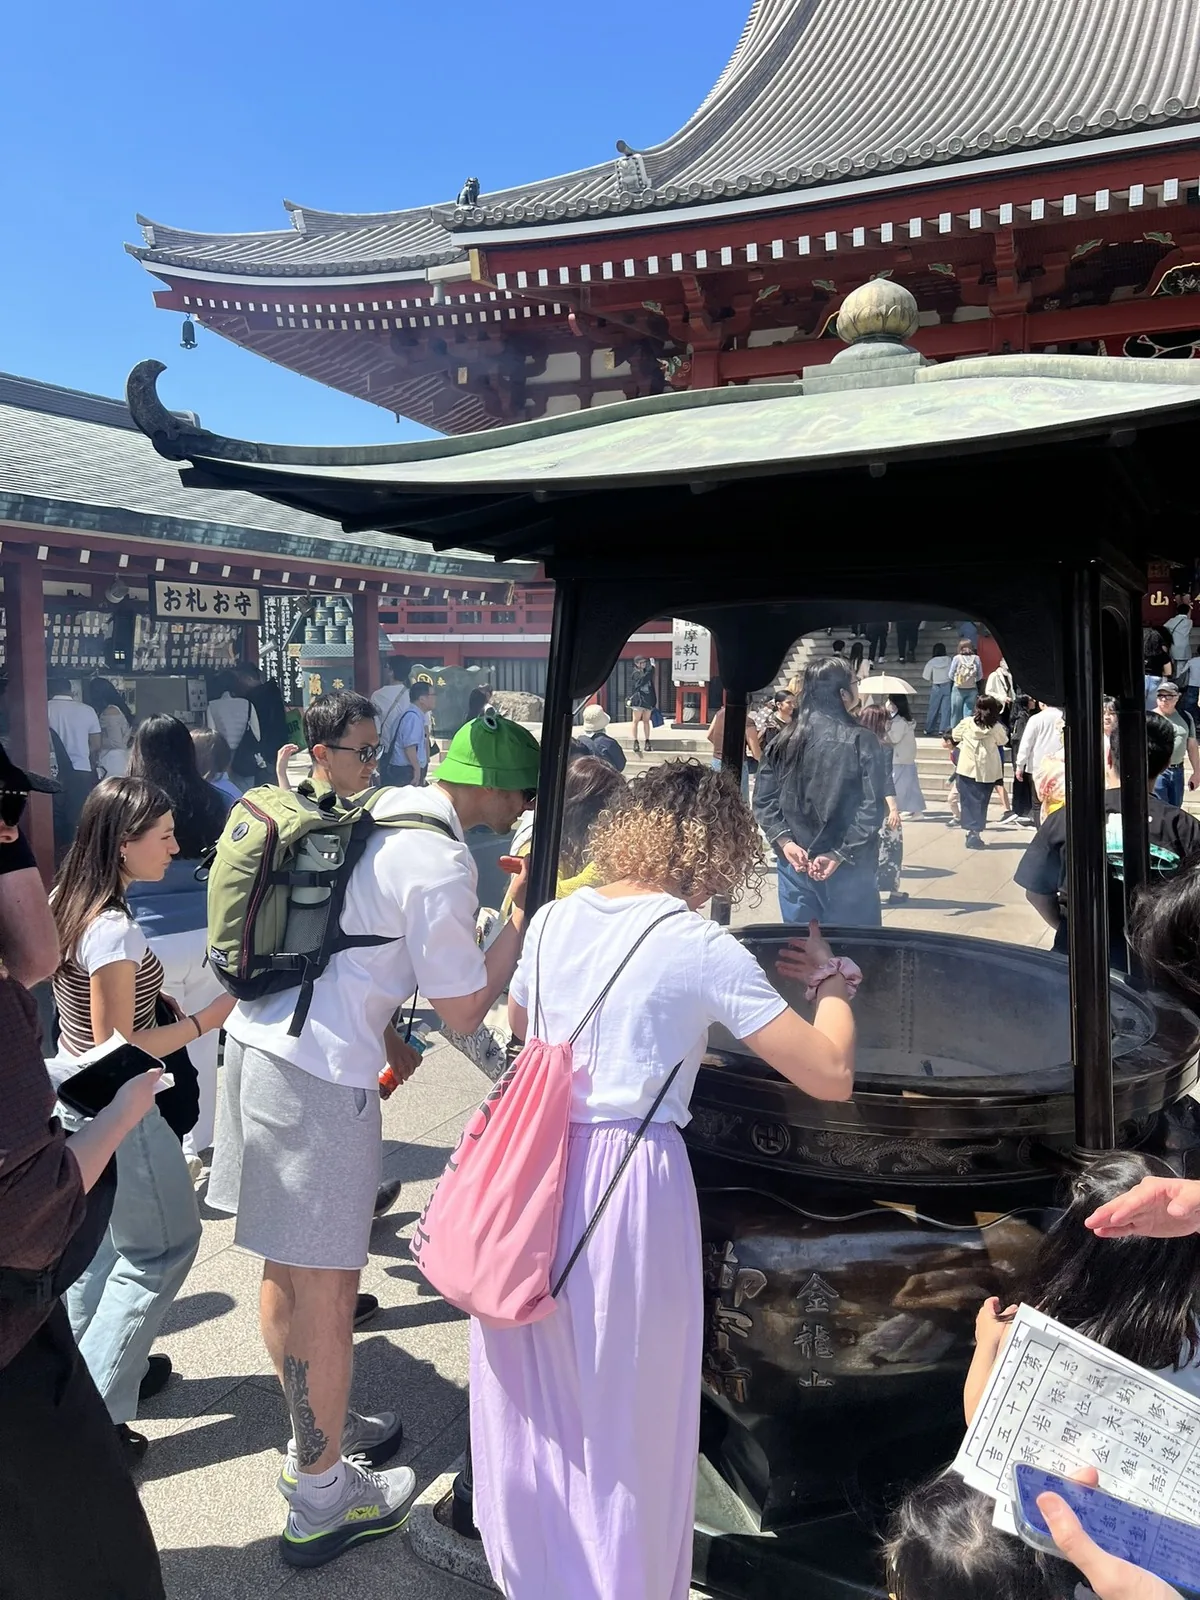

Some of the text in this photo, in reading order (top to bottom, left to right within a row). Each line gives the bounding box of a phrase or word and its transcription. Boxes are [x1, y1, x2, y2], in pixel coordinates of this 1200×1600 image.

[163, 585, 252, 617] お札お守
[793, 1272, 840, 1388] 金龍山
[345, 1504, 380, 1521] HOKA
